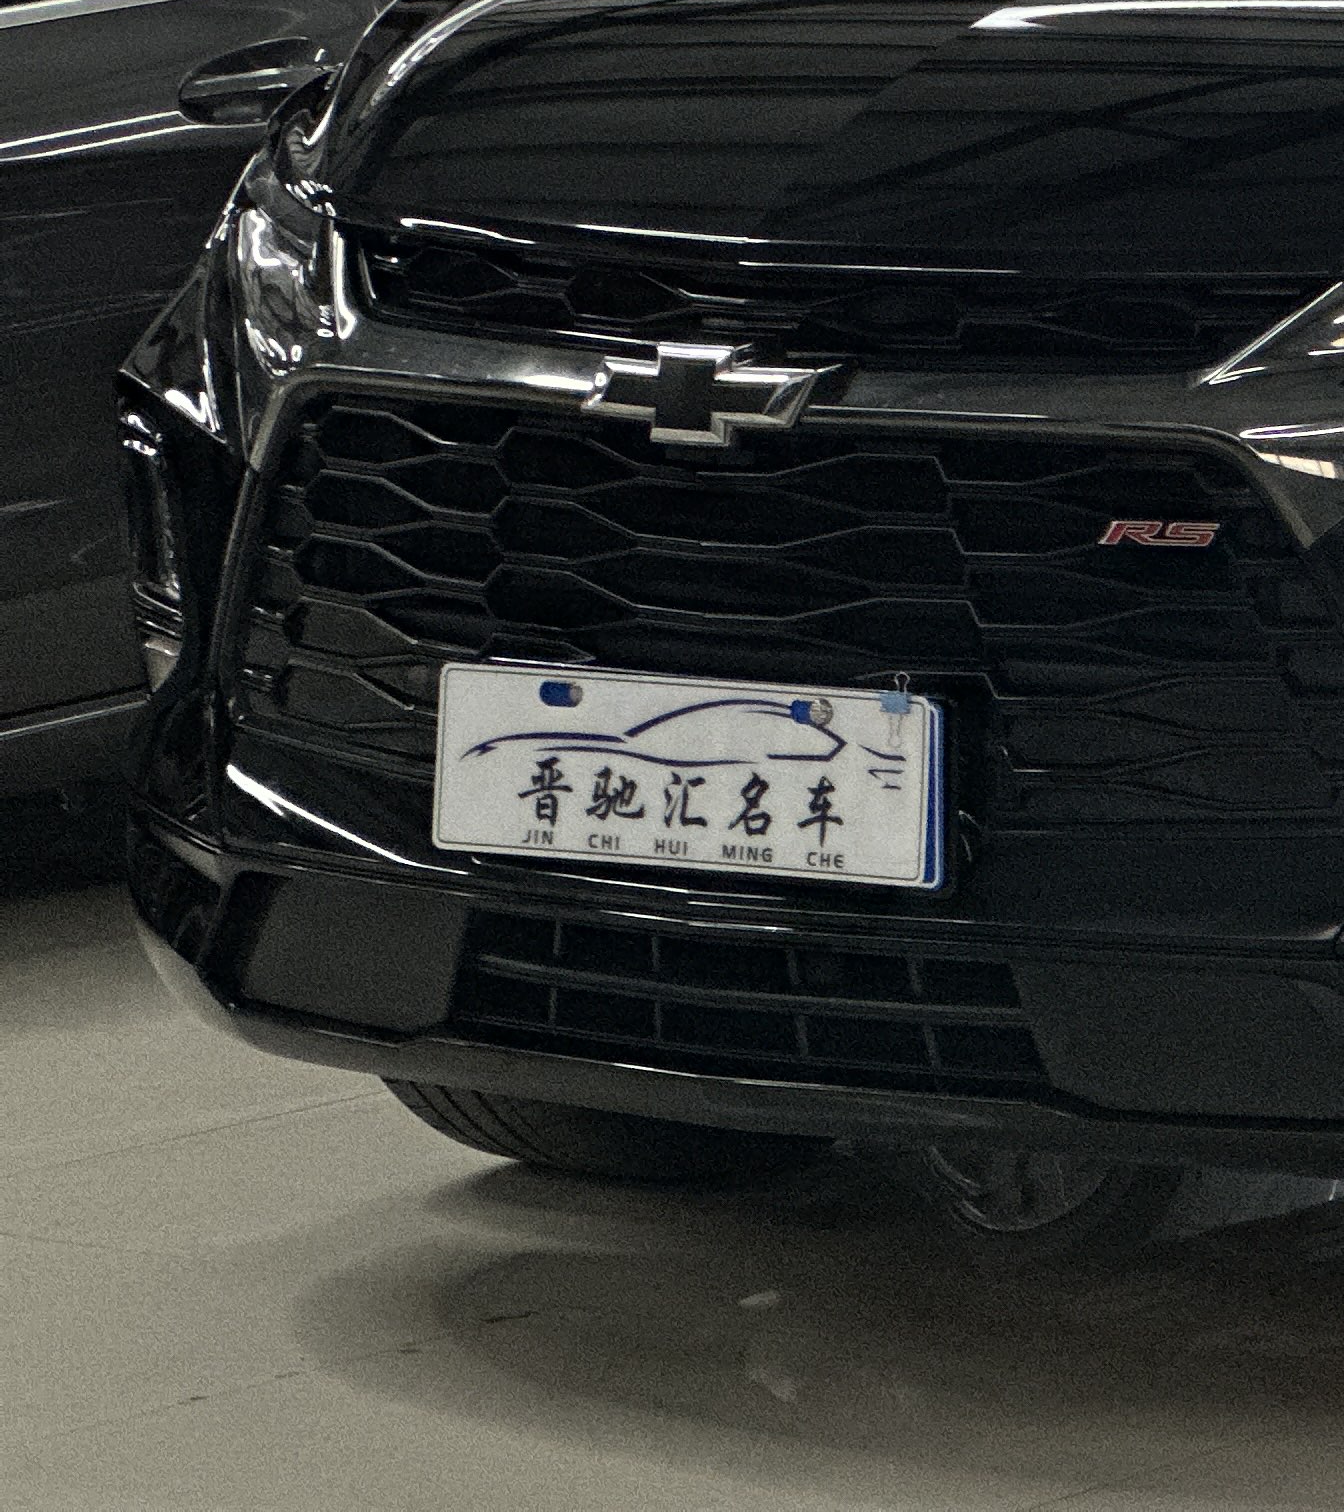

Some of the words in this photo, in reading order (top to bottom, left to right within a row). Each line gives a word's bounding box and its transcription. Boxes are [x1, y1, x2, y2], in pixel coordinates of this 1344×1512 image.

[1098, 520, 1220, 547] RS
[518, 756, 845, 848] 晋驰汇名车
[521, 829, 554, 845] JIN
[587, 833, 620, 850] CHI
[654, 839, 689, 857] HUI
[721, 844, 774, 863] MING
[806, 851, 845, 869] CHE
